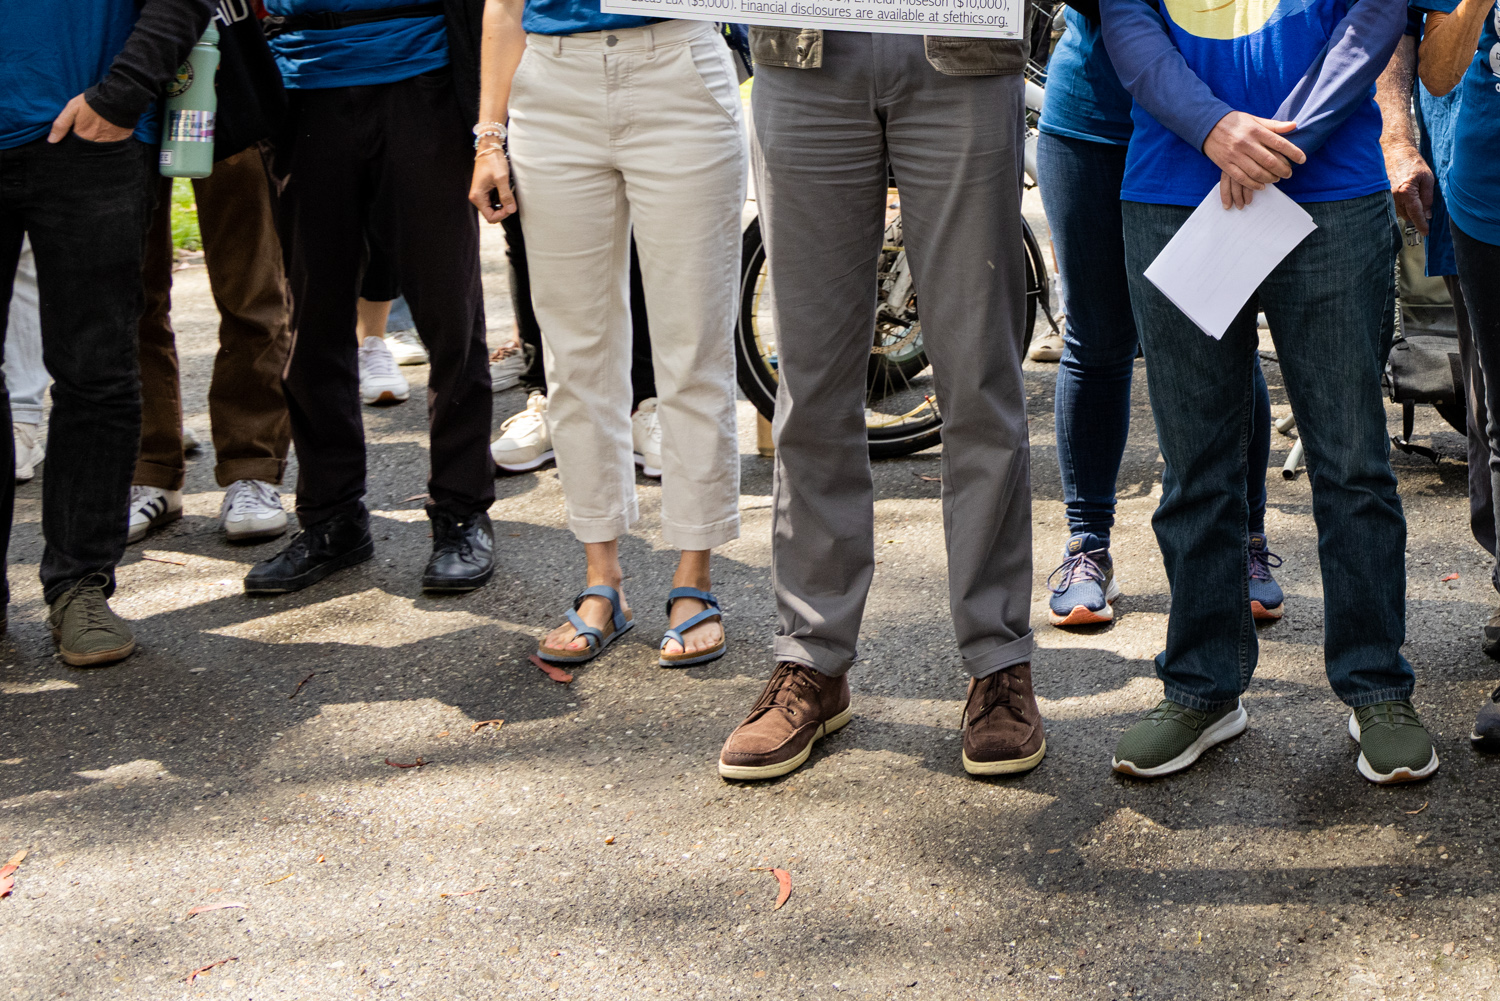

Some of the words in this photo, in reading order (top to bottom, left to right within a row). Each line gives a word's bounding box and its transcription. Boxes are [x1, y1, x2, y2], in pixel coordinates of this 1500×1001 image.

[790, 2, 852, 18] disclosures
[855, 8, 874, 19] are
[877, 8, 925, 22] available
[928, 10, 939, 23] at
[942, 10, 1008, 28] sfethics.org.
